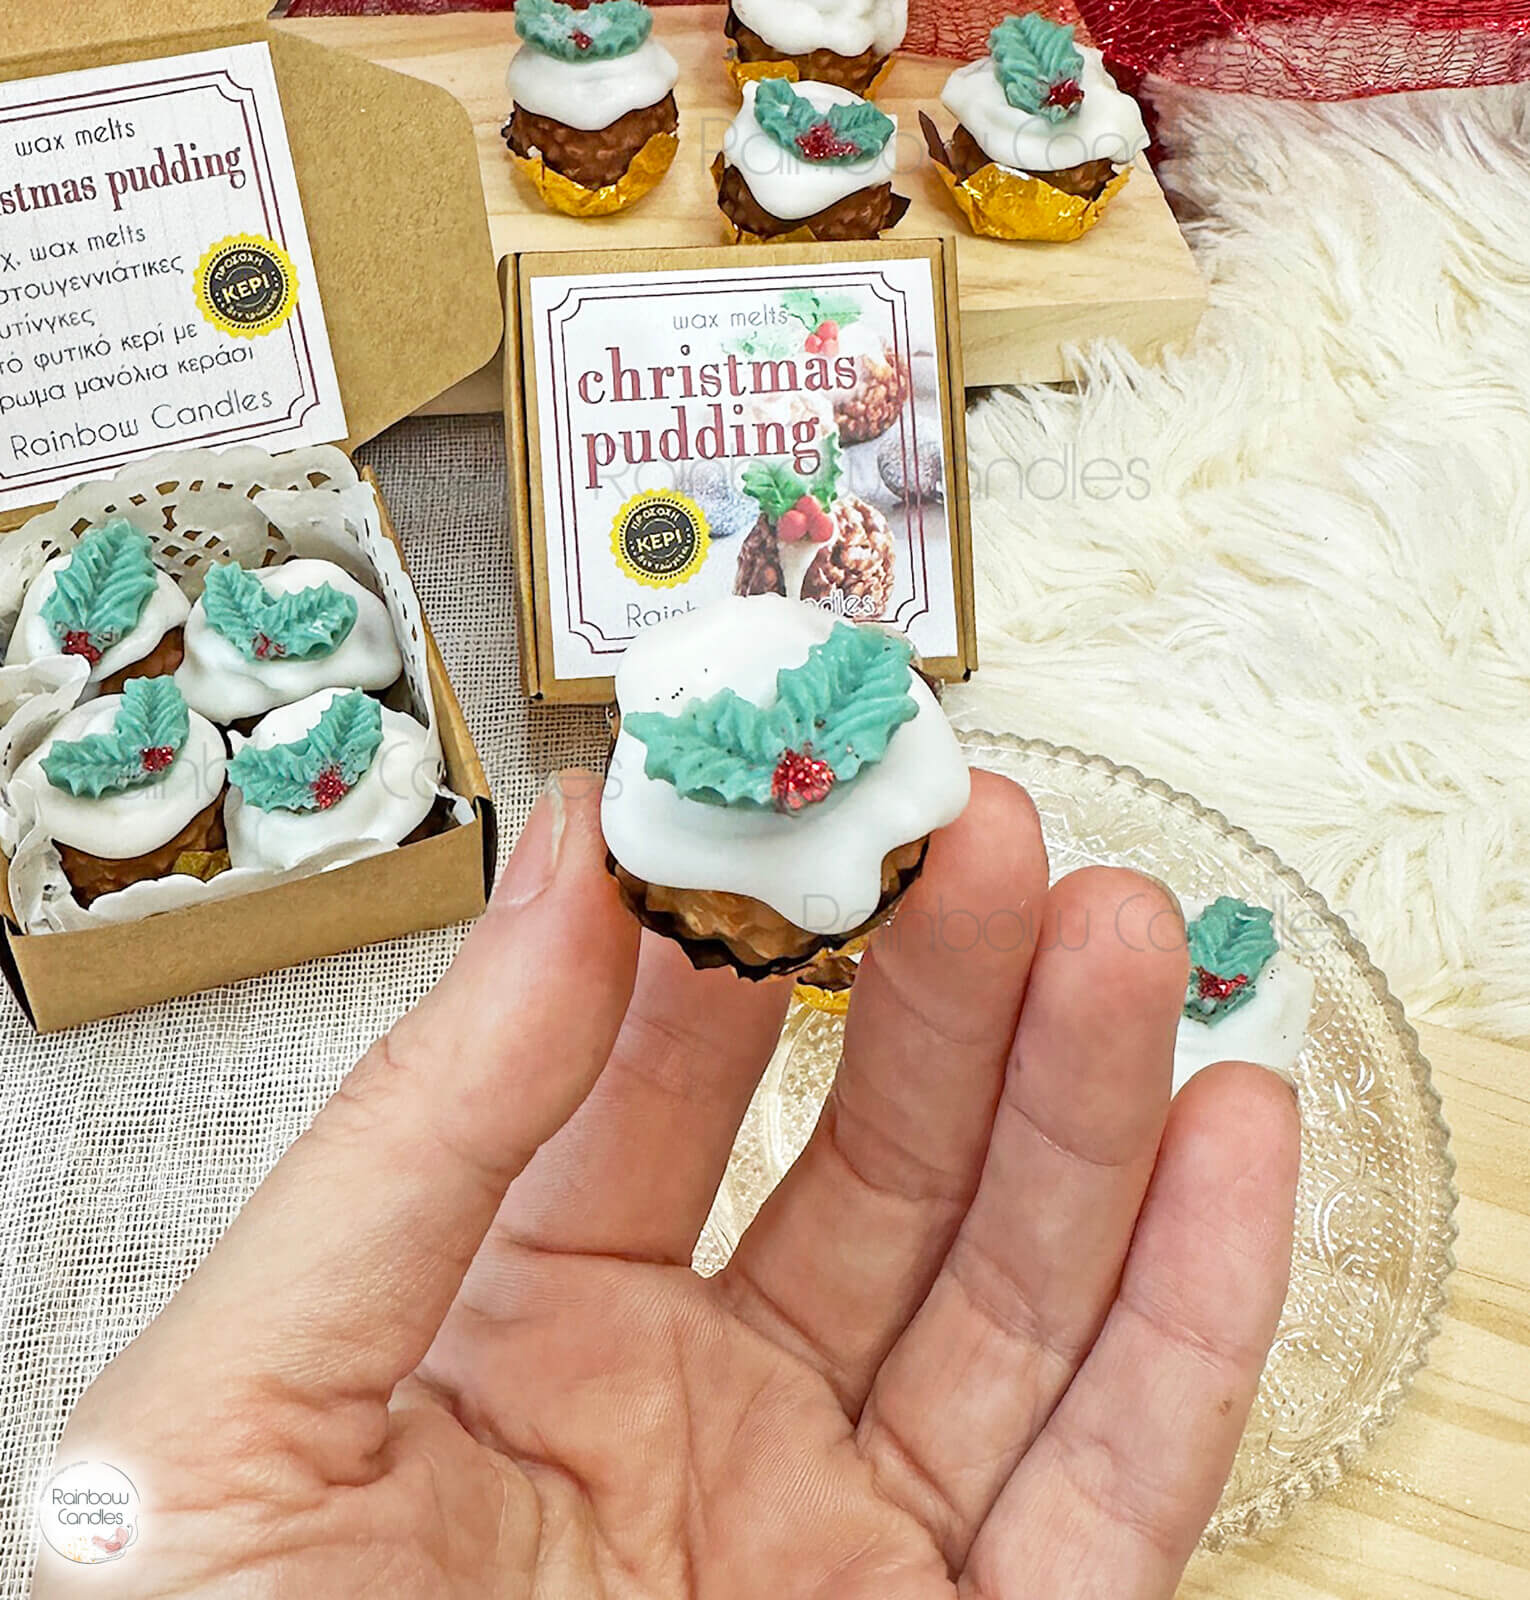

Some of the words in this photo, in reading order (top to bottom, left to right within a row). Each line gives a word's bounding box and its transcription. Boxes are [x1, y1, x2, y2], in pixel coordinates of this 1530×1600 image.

[15, 132, 65, 158] wax
[75, 117, 136, 146] melts
[0, 174, 97, 215] stmas
[105, 143, 246, 211] pudding
[30, 241, 79, 262] wax
[88, 224, 146, 251] melts
[673, 311, 719, 330] wax
[731, 303, 789, 328] melts
[34, 333, 112, 372] φυτικό
[121, 322, 165, 352] κερί
[175, 323, 198, 345] με
[75, 362, 169, 401] μανόλια
[178, 343, 255, 375] κεράσι
[577, 344, 858, 405] christmas
[10, 414, 140, 461] Rainbow
[151, 389, 273, 430] Candles
[581, 402, 820, 489] pudding
